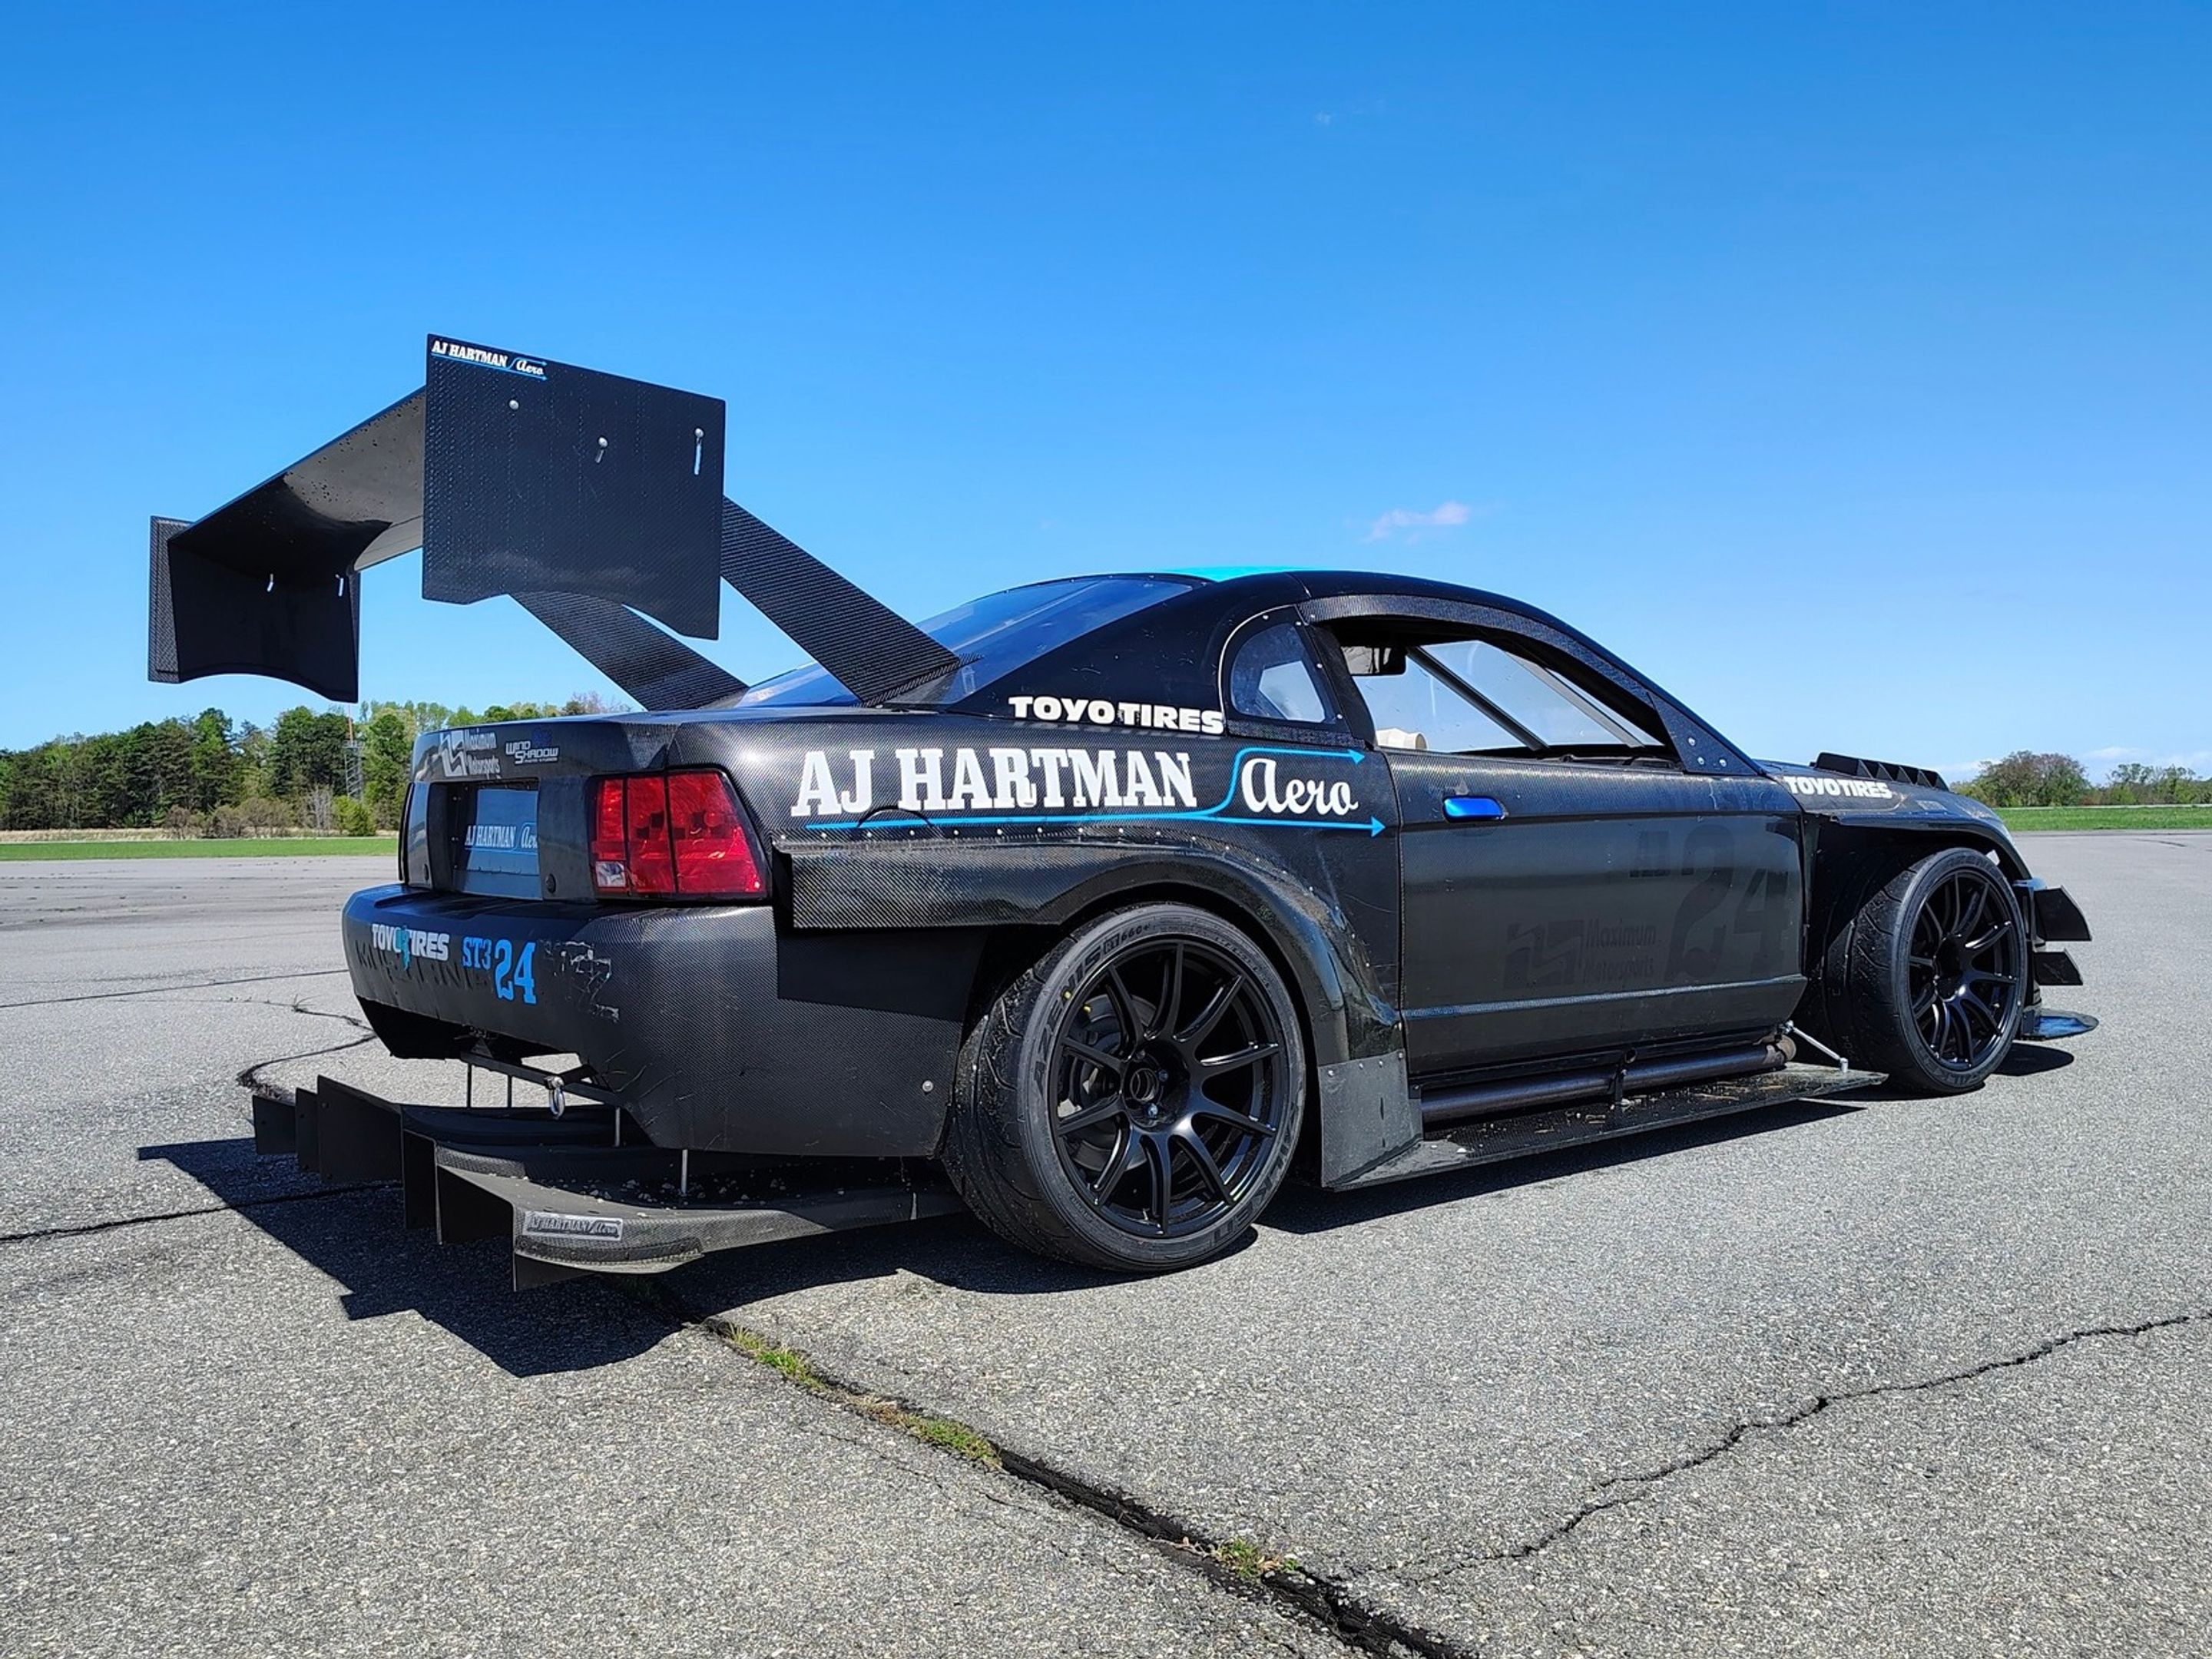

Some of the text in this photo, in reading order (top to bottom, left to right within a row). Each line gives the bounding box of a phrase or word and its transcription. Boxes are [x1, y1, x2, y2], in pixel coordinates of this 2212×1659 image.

[432, 340, 544, 375] AJ HARTMAN Aero
[515, 747, 559, 765] SHADOW
[790, 747, 1359, 817] AJ HARTMAN Aero
[465, 825, 476, 846] AJ
[475, 826, 516, 849] HARTMAN
[462, 935, 492, 971] ST3
[494, 939, 538, 1005] 24
